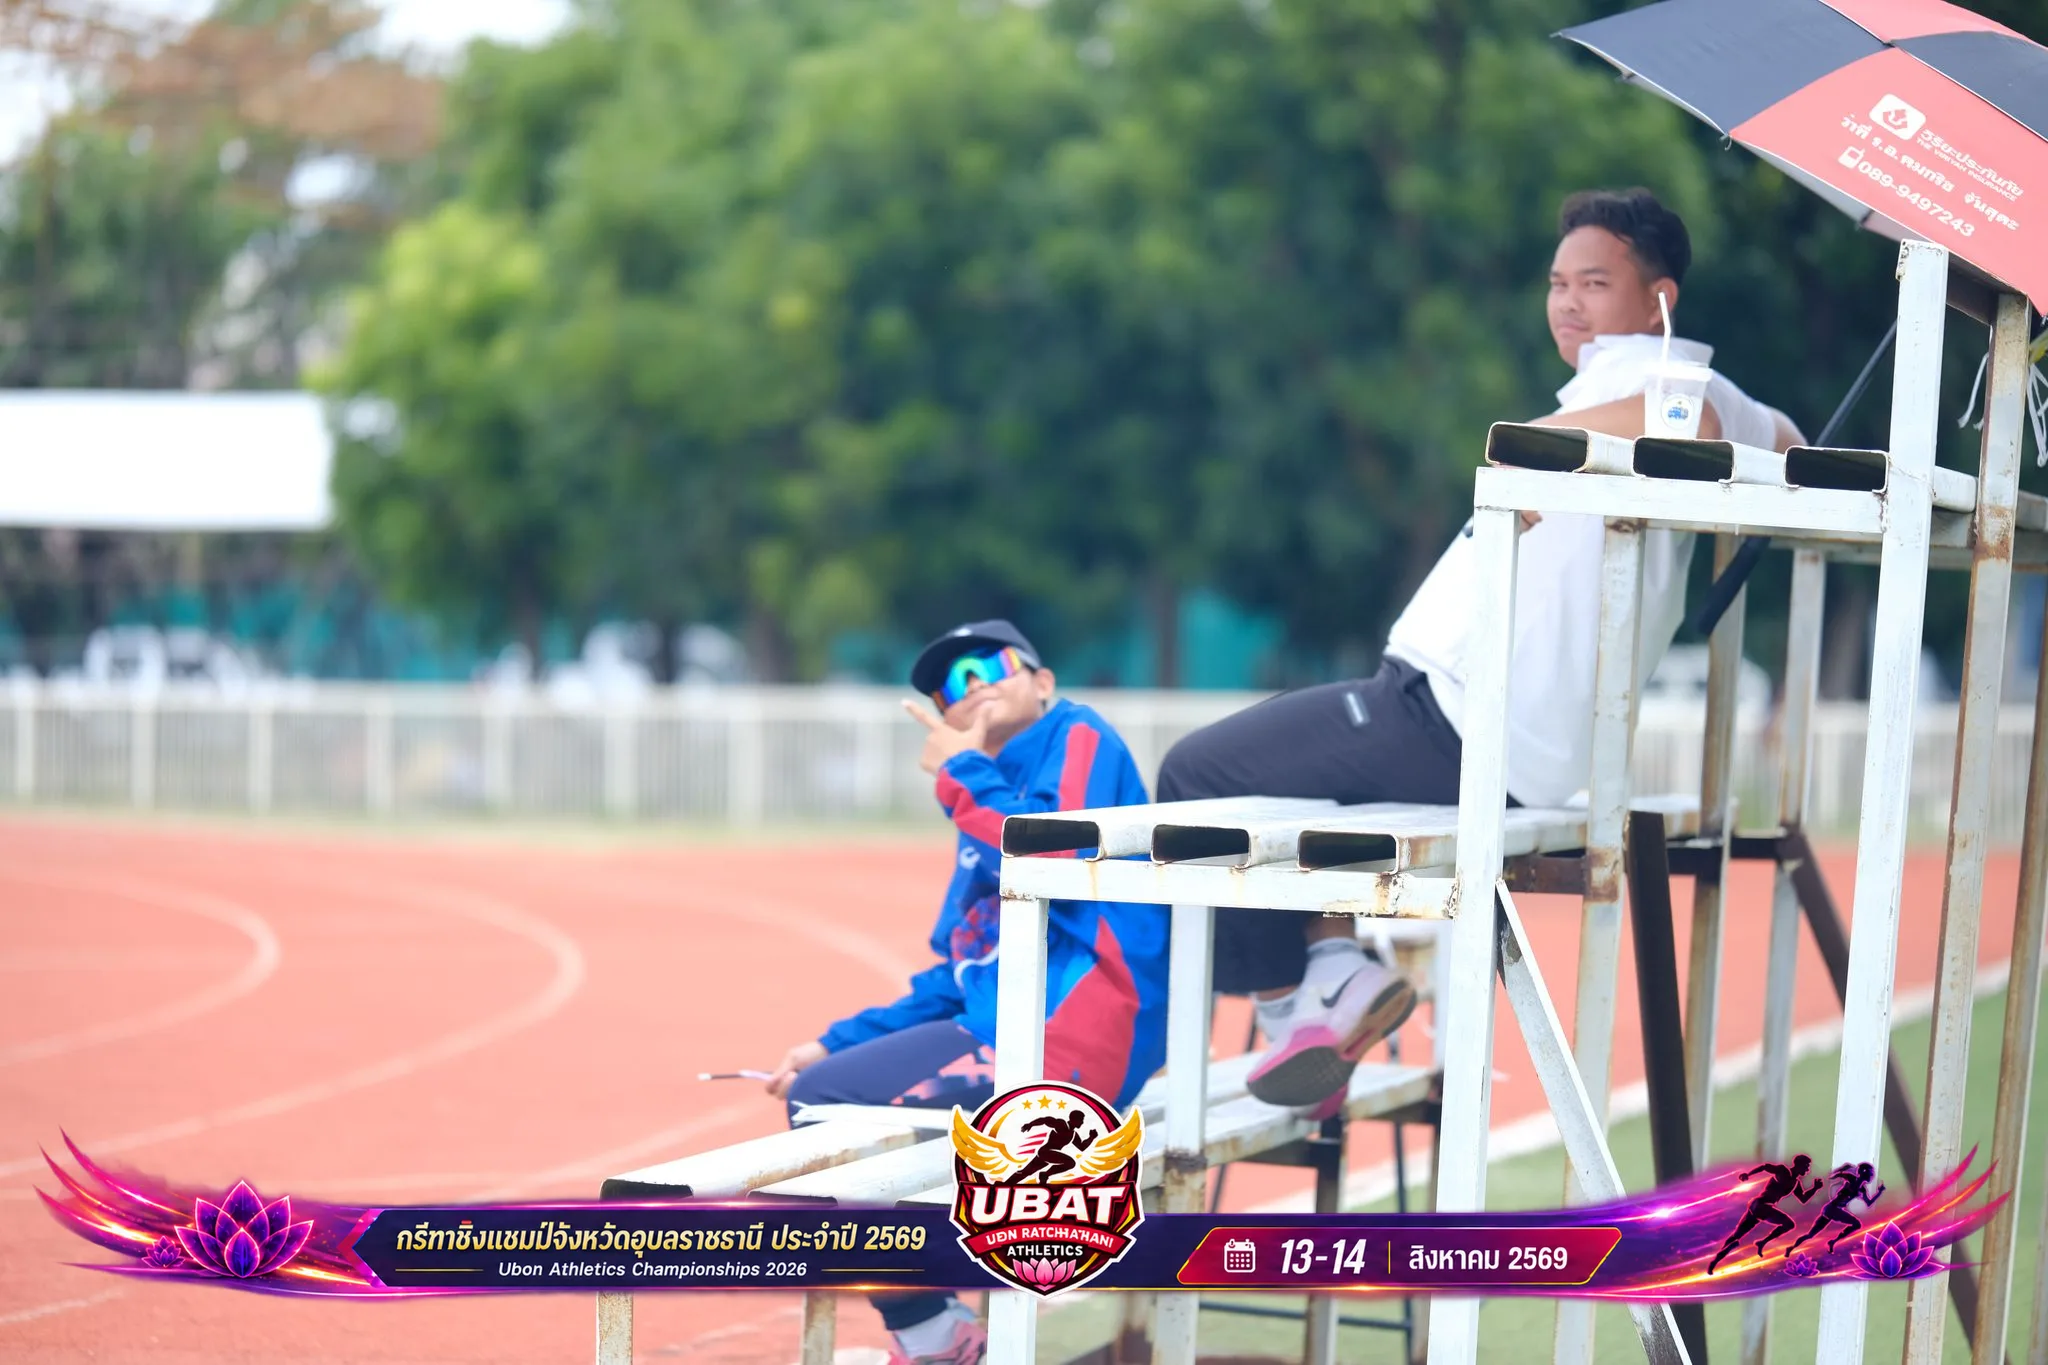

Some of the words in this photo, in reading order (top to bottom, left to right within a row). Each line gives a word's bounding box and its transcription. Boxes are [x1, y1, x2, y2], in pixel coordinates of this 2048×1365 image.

[1857, 160, 1976, 238] 089-9497243
[1916, 137, 1934, 151] THE
[1967, 169, 2017, 203] INSURANCE
